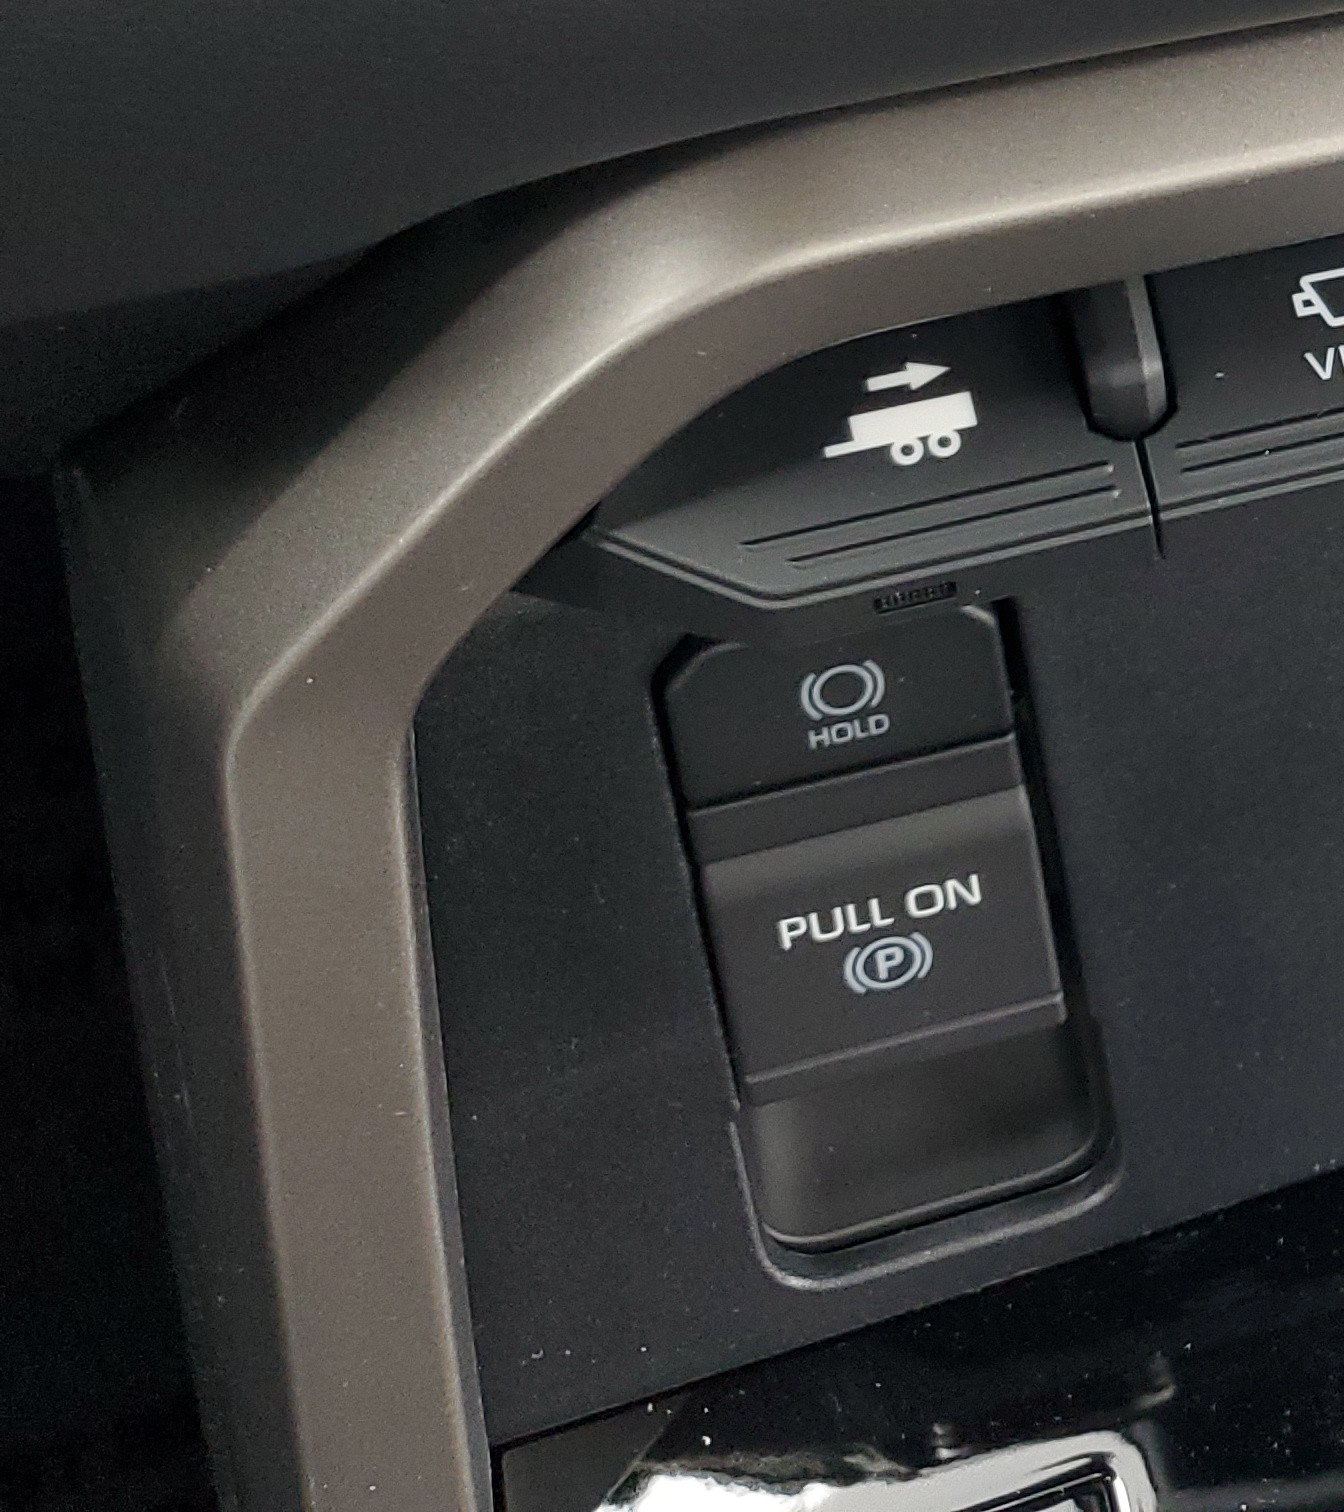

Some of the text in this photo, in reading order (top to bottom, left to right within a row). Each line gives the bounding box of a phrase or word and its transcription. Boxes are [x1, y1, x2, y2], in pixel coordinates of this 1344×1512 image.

[807, 713, 891, 750] HOLD
[776, 873, 983, 951] PULL ON
